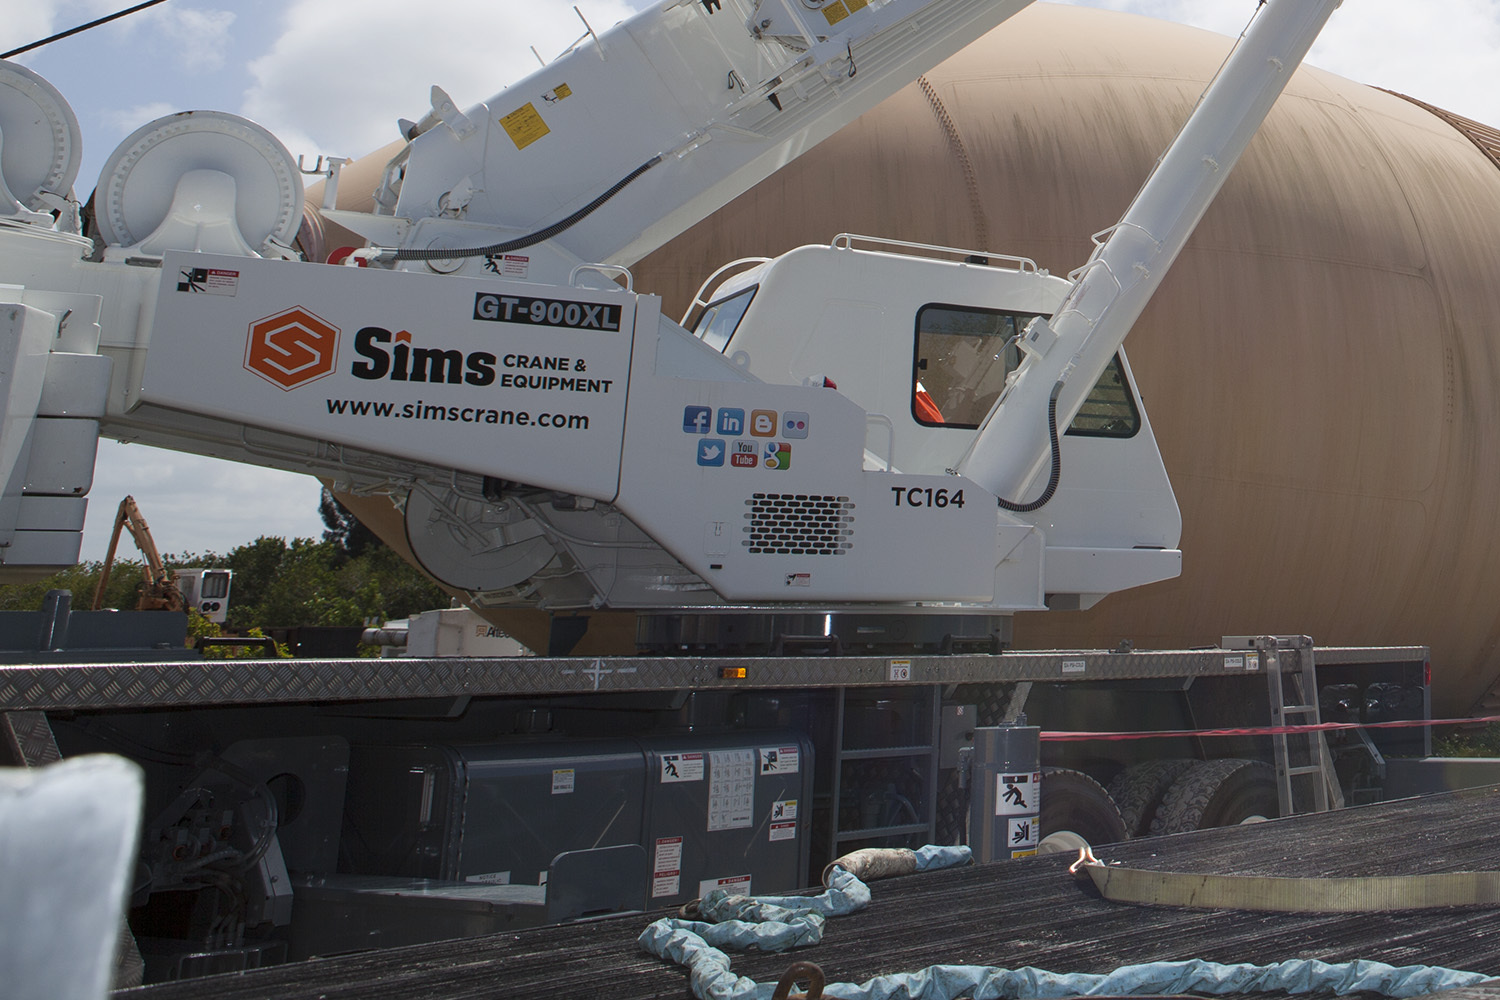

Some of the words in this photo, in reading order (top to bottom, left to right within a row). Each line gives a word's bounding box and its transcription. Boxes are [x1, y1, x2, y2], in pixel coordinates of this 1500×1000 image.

[475, 294, 620, 330] GT-900XL
[350, 325, 497, 387] Sims
[503, 353, 570, 372] CRANE
[574, 358, 587, 372] &
[500, 374, 613, 394] EQUIPMENT
[326, 398, 590, 430] www.simscrane.com
[738, 442, 753, 453] You
[736, 454, 753, 465] Tube
[891, 486, 965, 509] TC164
